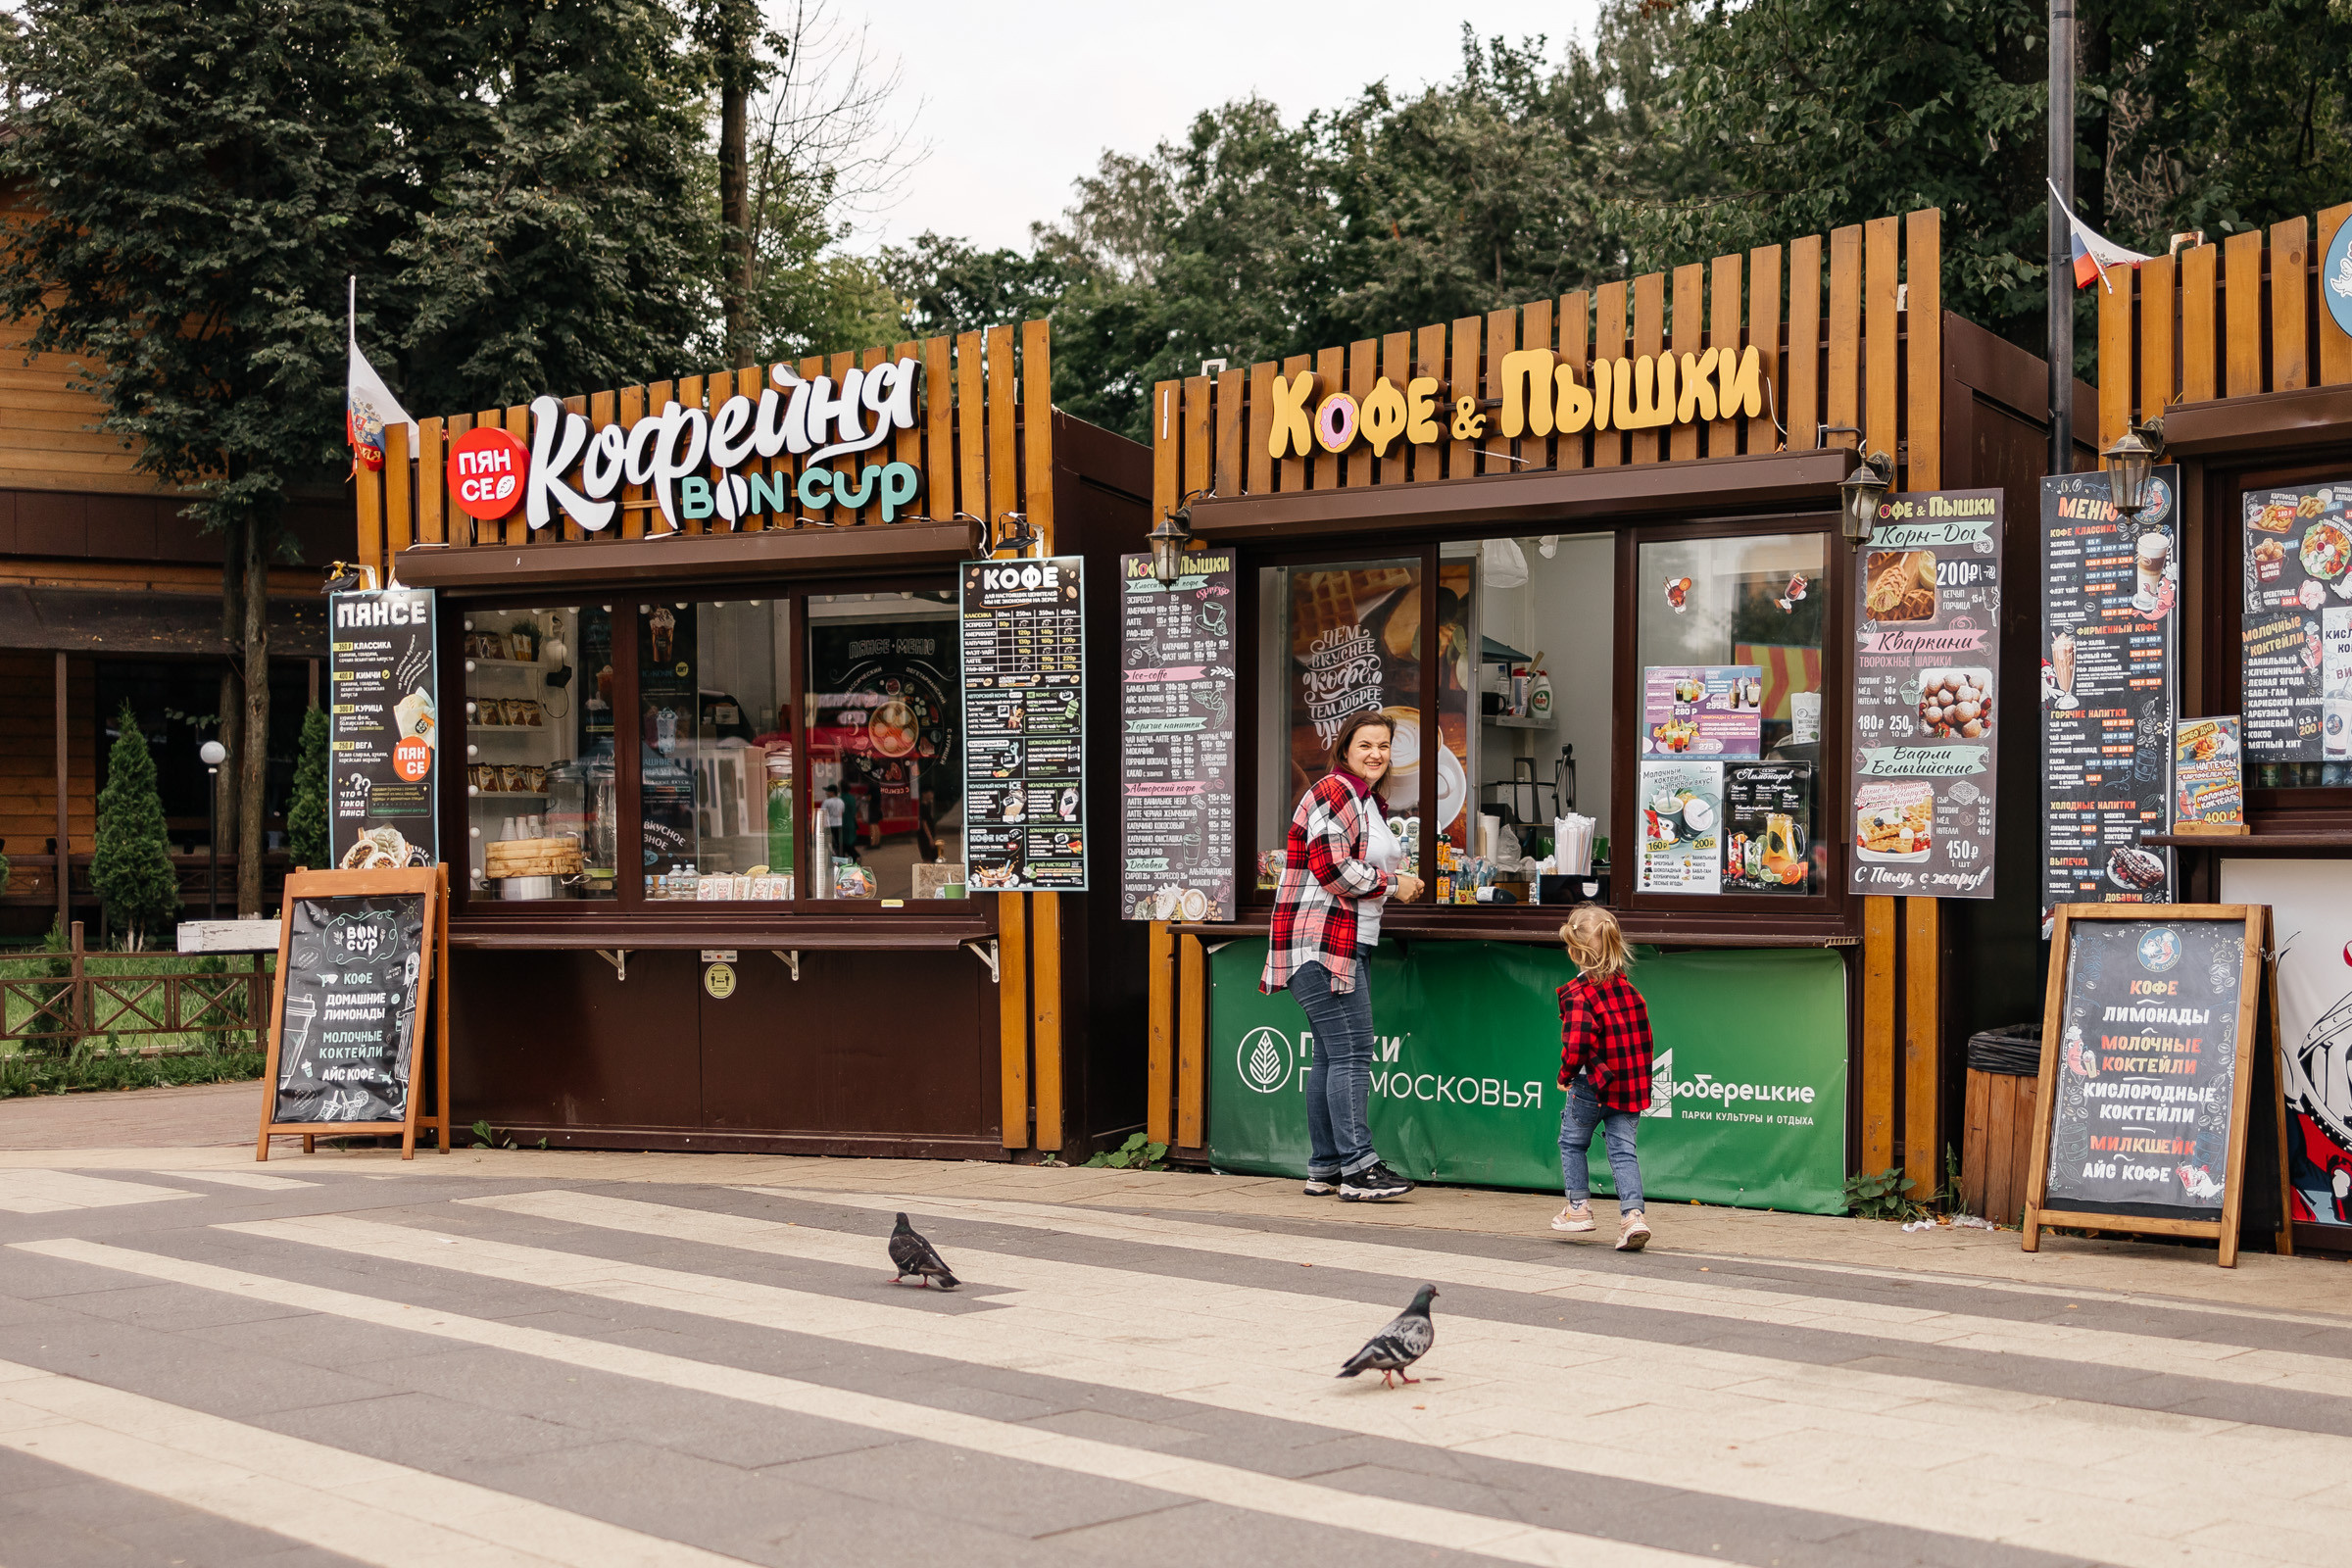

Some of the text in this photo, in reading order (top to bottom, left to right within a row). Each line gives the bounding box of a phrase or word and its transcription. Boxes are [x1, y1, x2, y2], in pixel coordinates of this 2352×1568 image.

[1451, 395, 1487, 440] &
[526, 357, 917, 531] Кофейня
[458, 448, 512, 475] ПЯН
[461, 476, 496, 502] СЕ
[1917, 506, 1927, 516] &
[1930, 496, 1995, 517] ПЫШКИ
[2058, 497, 2118, 521] МЕНЮ
[1880, 523, 1977, 549] Корн-Дог
[2050, 524, 2117, 537] КОФЕ КЛАССИКА
[984, 564, 1058, 591] КОФЕ
[1943, 602, 1970, 611] ГОРЧИЦА
[336, 600, 427, 627] ПЯНСЕ
[1127, 617, 1142, 626] ЛАТТЕ
[2077, 622, 2157, 635] ФИРМЕННЫЙ КОФЕ
[2242, 615, 2301, 643] МОЛОЧНЫЕ
[1322, 624, 1362, 648] ЧЕМ
[354, 641, 392, 650] КЛАССИКА
[849, 638, 935, 659] ПЯНСЕ МЕНЮ
[1162, 642, 1189, 651] КАПУЧИНО
[1879, 631, 1972, 656] Кваркини
[2250, 632, 2305, 657] КОКТЕЙЛИ
[1312, 640, 1375, 667] ВКУСНЕЕ
[1860, 656, 1951, 667] ТВОРОЖНЫЕ ШАРИКИ
[2248, 655, 2297, 666] ВАНИЛЬНЫЙ
[1132, 669, 1167, 682] Ice-coffe
[2248, 664, 2302, 676] КЛУБНИЧНЫЙ
[2248, 676, 2304, 687] ЛЕСНАЯ ЯГОДА
[2248, 688, 2287, 697] БАБЛ-ГАМ
[1308, 688, 1383, 718] ТЕМ ДОБРЕЕ
[2248, 697, 2323, 708] КАРИБСКИЙ АНАНАС
[2051, 709, 2127, 719] ГОРЯЧИЕ НАПИТКИ
[2248, 708, 2289, 717] АРБУЗНЫЙ
[1131, 721, 1160, 733] Горячие
[1858, 715, 1884, 730] 180₽
[2248, 717, 2293, 728] ВИШНЕВЫЙ
[2178, 723, 2214, 745] КОМБО ДНЯ
[2248, 730, 2272, 739] КОКОС
[2299, 724, 2317, 736] 200
[2248, 739, 2302, 750] МЯТНЫЙ ХИТ
[398, 747, 425, 760] ПЯН
[1893, 747, 1951, 764] Вафли
[407, 762, 425, 774] СЕ
[1872, 760, 1973, 774] Бельгийские
[2196, 759, 2236, 771] НАГГЕТСЫ
[1642, 766, 1682, 779] Молочный
[1737, 768, 1793, 784] Лимонадов
[2182, 771, 2223, 780] КАРТОФЕЛЕМ
[1694, 777, 1713, 786] вкус!
[2227, 777, 2234, 787] &
[1130, 783, 1195, 796] Авторский кофе
[2197, 785, 2239, 803] МОЛОЧНЫЙ
[2050, 801, 2135, 810] ХОЛОДНЫЕ НАПИТКИ
[2201, 795, 2239, 809] КОКТЕЙЛЬ
[1936, 816, 1949, 825] МЁД
[2204, 810, 2236, 823] 400 Р
[1946, 841, 1979, 859] 150₽
[1130, 860, 1163, 869] Добавки
[2049, 858, 2088, 866] ВЫПЕЧКА
[1855, 866, 1868, 883] С
[1931, 866, 1990, 891] жару!
[343, 972, 372, 985] КОФЕ
[2131, 981, 2179, 995] КОФЕ
[325, 993, 386, 1006] ДОМАШНИЕ
[323, 1006, 385, 1021] ЛИМОНАДЫ
[2103, 1006, 2210, 1025] ЛИМОНАДЫ
[323, 1030, 382, 1043] МОЛОЧНЫЕ
[2101, 1036, 2202, 1053] МОЛОЧНЫЕ
[319, 1045, 382, 1058] КОКТЕЙЛИ
[2102, 1055, 2197, 1074] КОКТЕЙЛИ
[321, 1066, 375, 1081] АЙС КОФЕ
[2083, 1083, 2216, 1102] КИСЛОРОДНЫЕ
[1682, 1110, 1814, 1126] ПАРКИ КУЛЬТУРЫ И ОТДЫХА
[2100, 1102, 2195, 1123] КОКТЕЙЛИ
[2090, 1135, 2196, 1155] МИЛКШЕЙК
[2082, 1160, 2171, 1182] АЙС КОФЕ
